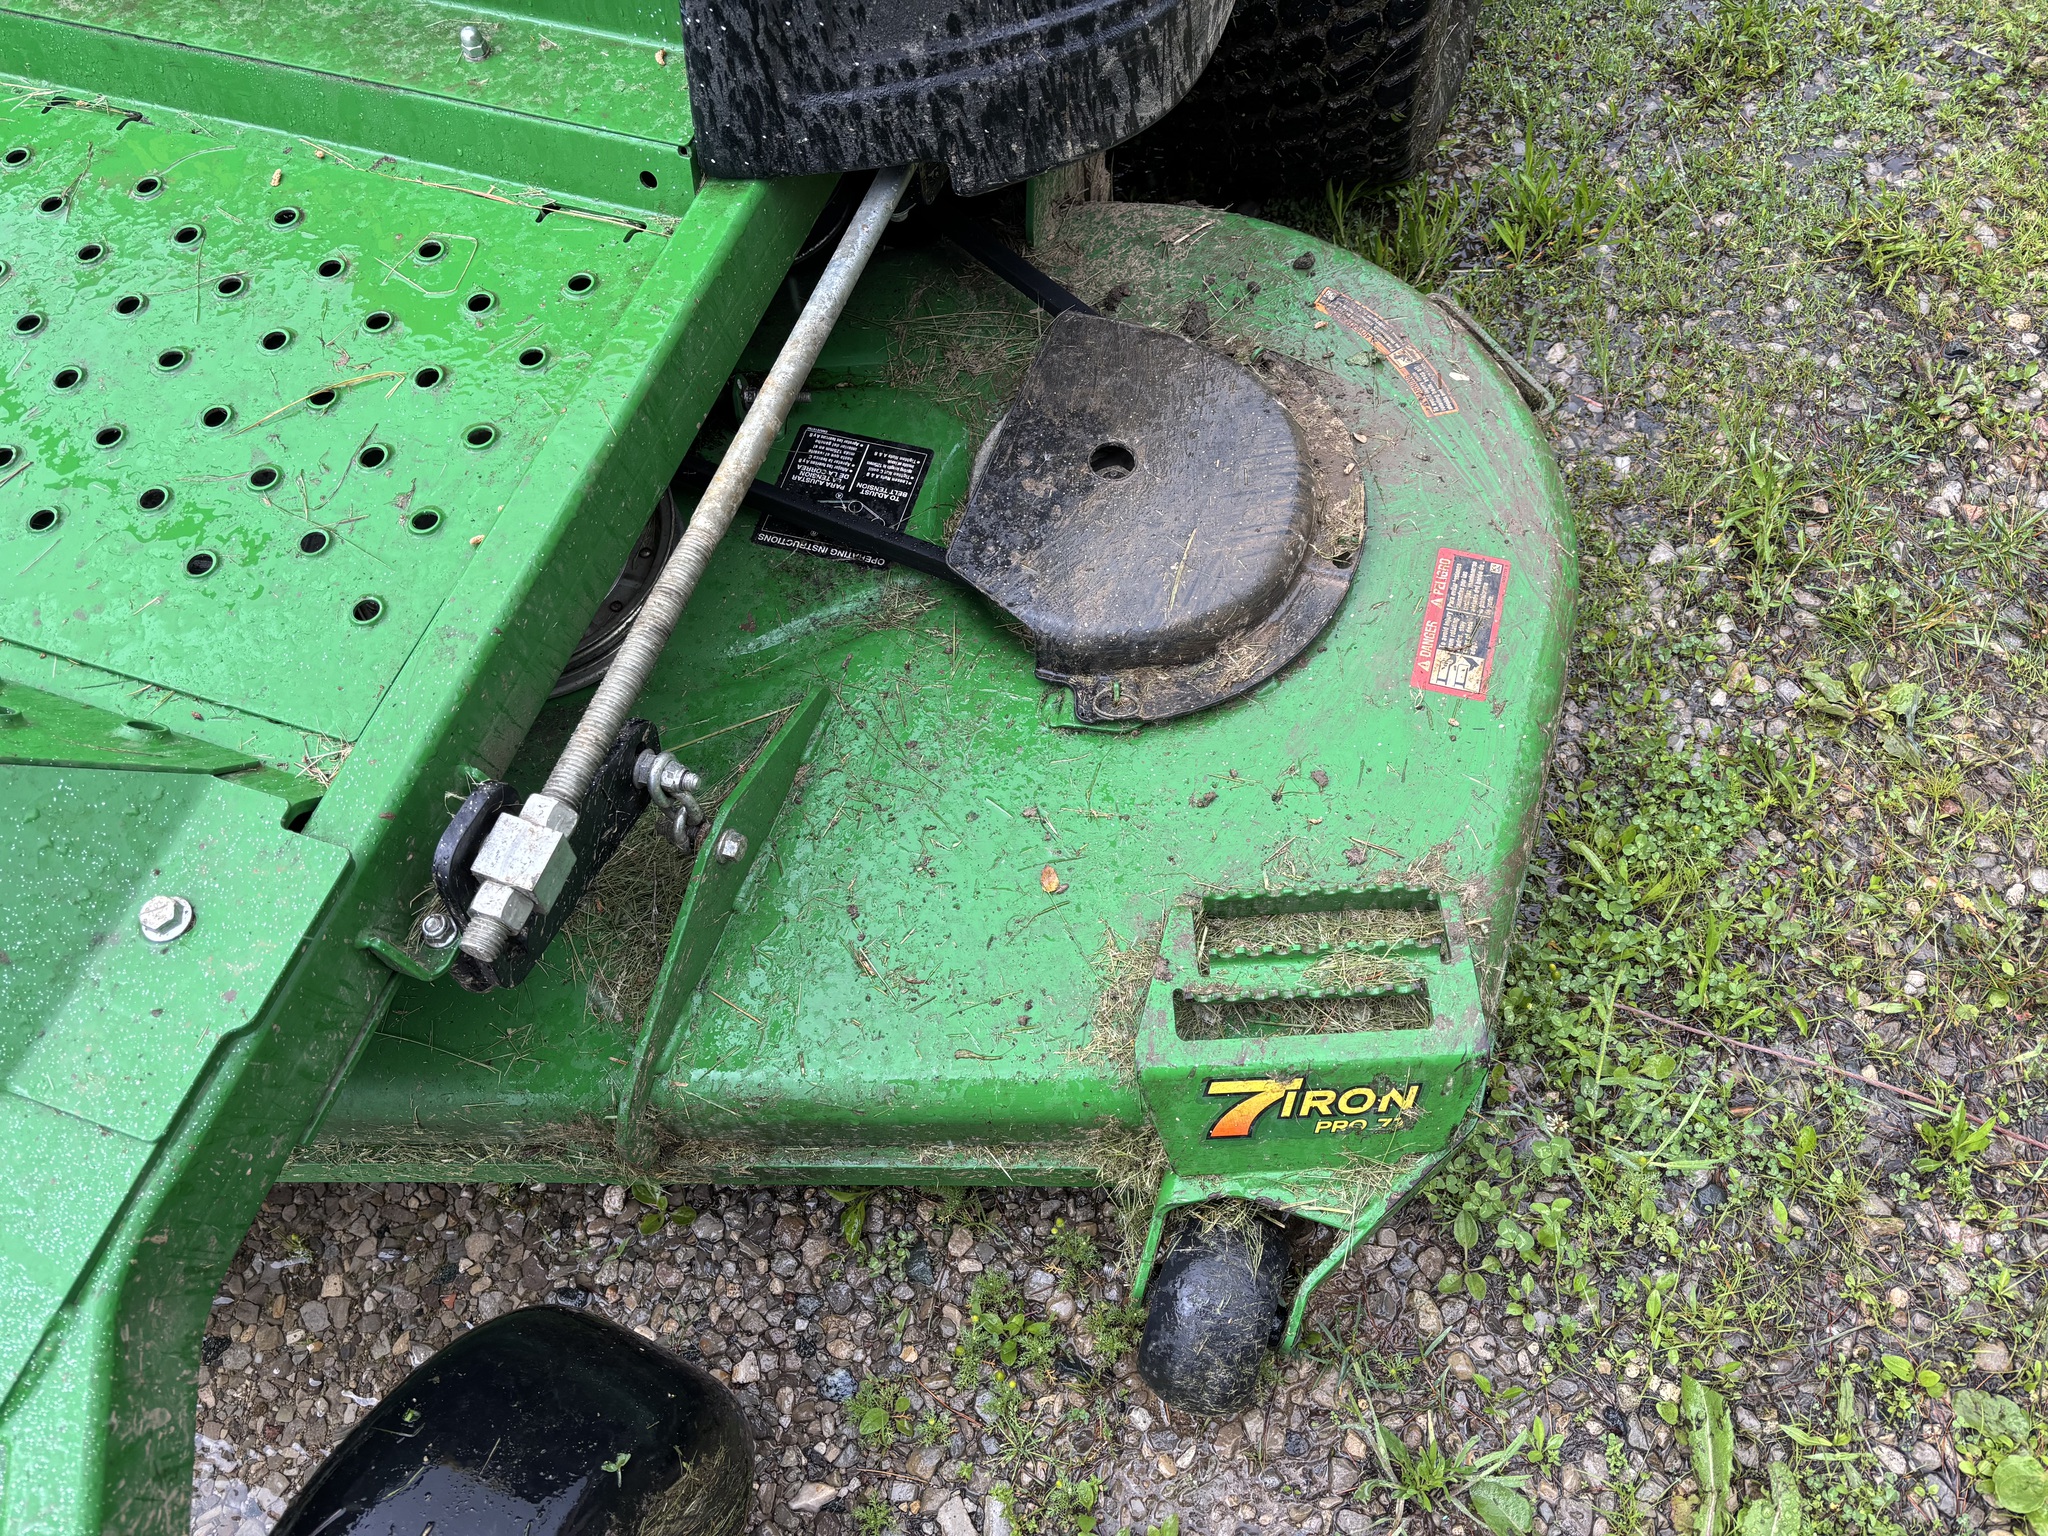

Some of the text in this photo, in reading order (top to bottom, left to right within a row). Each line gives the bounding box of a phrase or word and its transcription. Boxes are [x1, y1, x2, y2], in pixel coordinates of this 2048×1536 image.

[797, 464, 827, 475] CORREA
[799, 470, 830, 481] TENSION
[838, 472, 850, 480] DE
[791, 474, 845, 490] PARA AJUSTAR
[856, 482, 908, 498] BELT TENSION
[859, 488, 899, 502] TO ADJUST
[757, 533, 885, 565] OPERATING INSTRUCTIONS
[1433, 557, 1450, 595] PELIGRO
[1447, 596, 1455, 607] Para
[1420, 620, 1437, 657] DANGER
[1454, 633, 1463, 651] lades,
[1314, 1118, 1369, 1134] PRO
